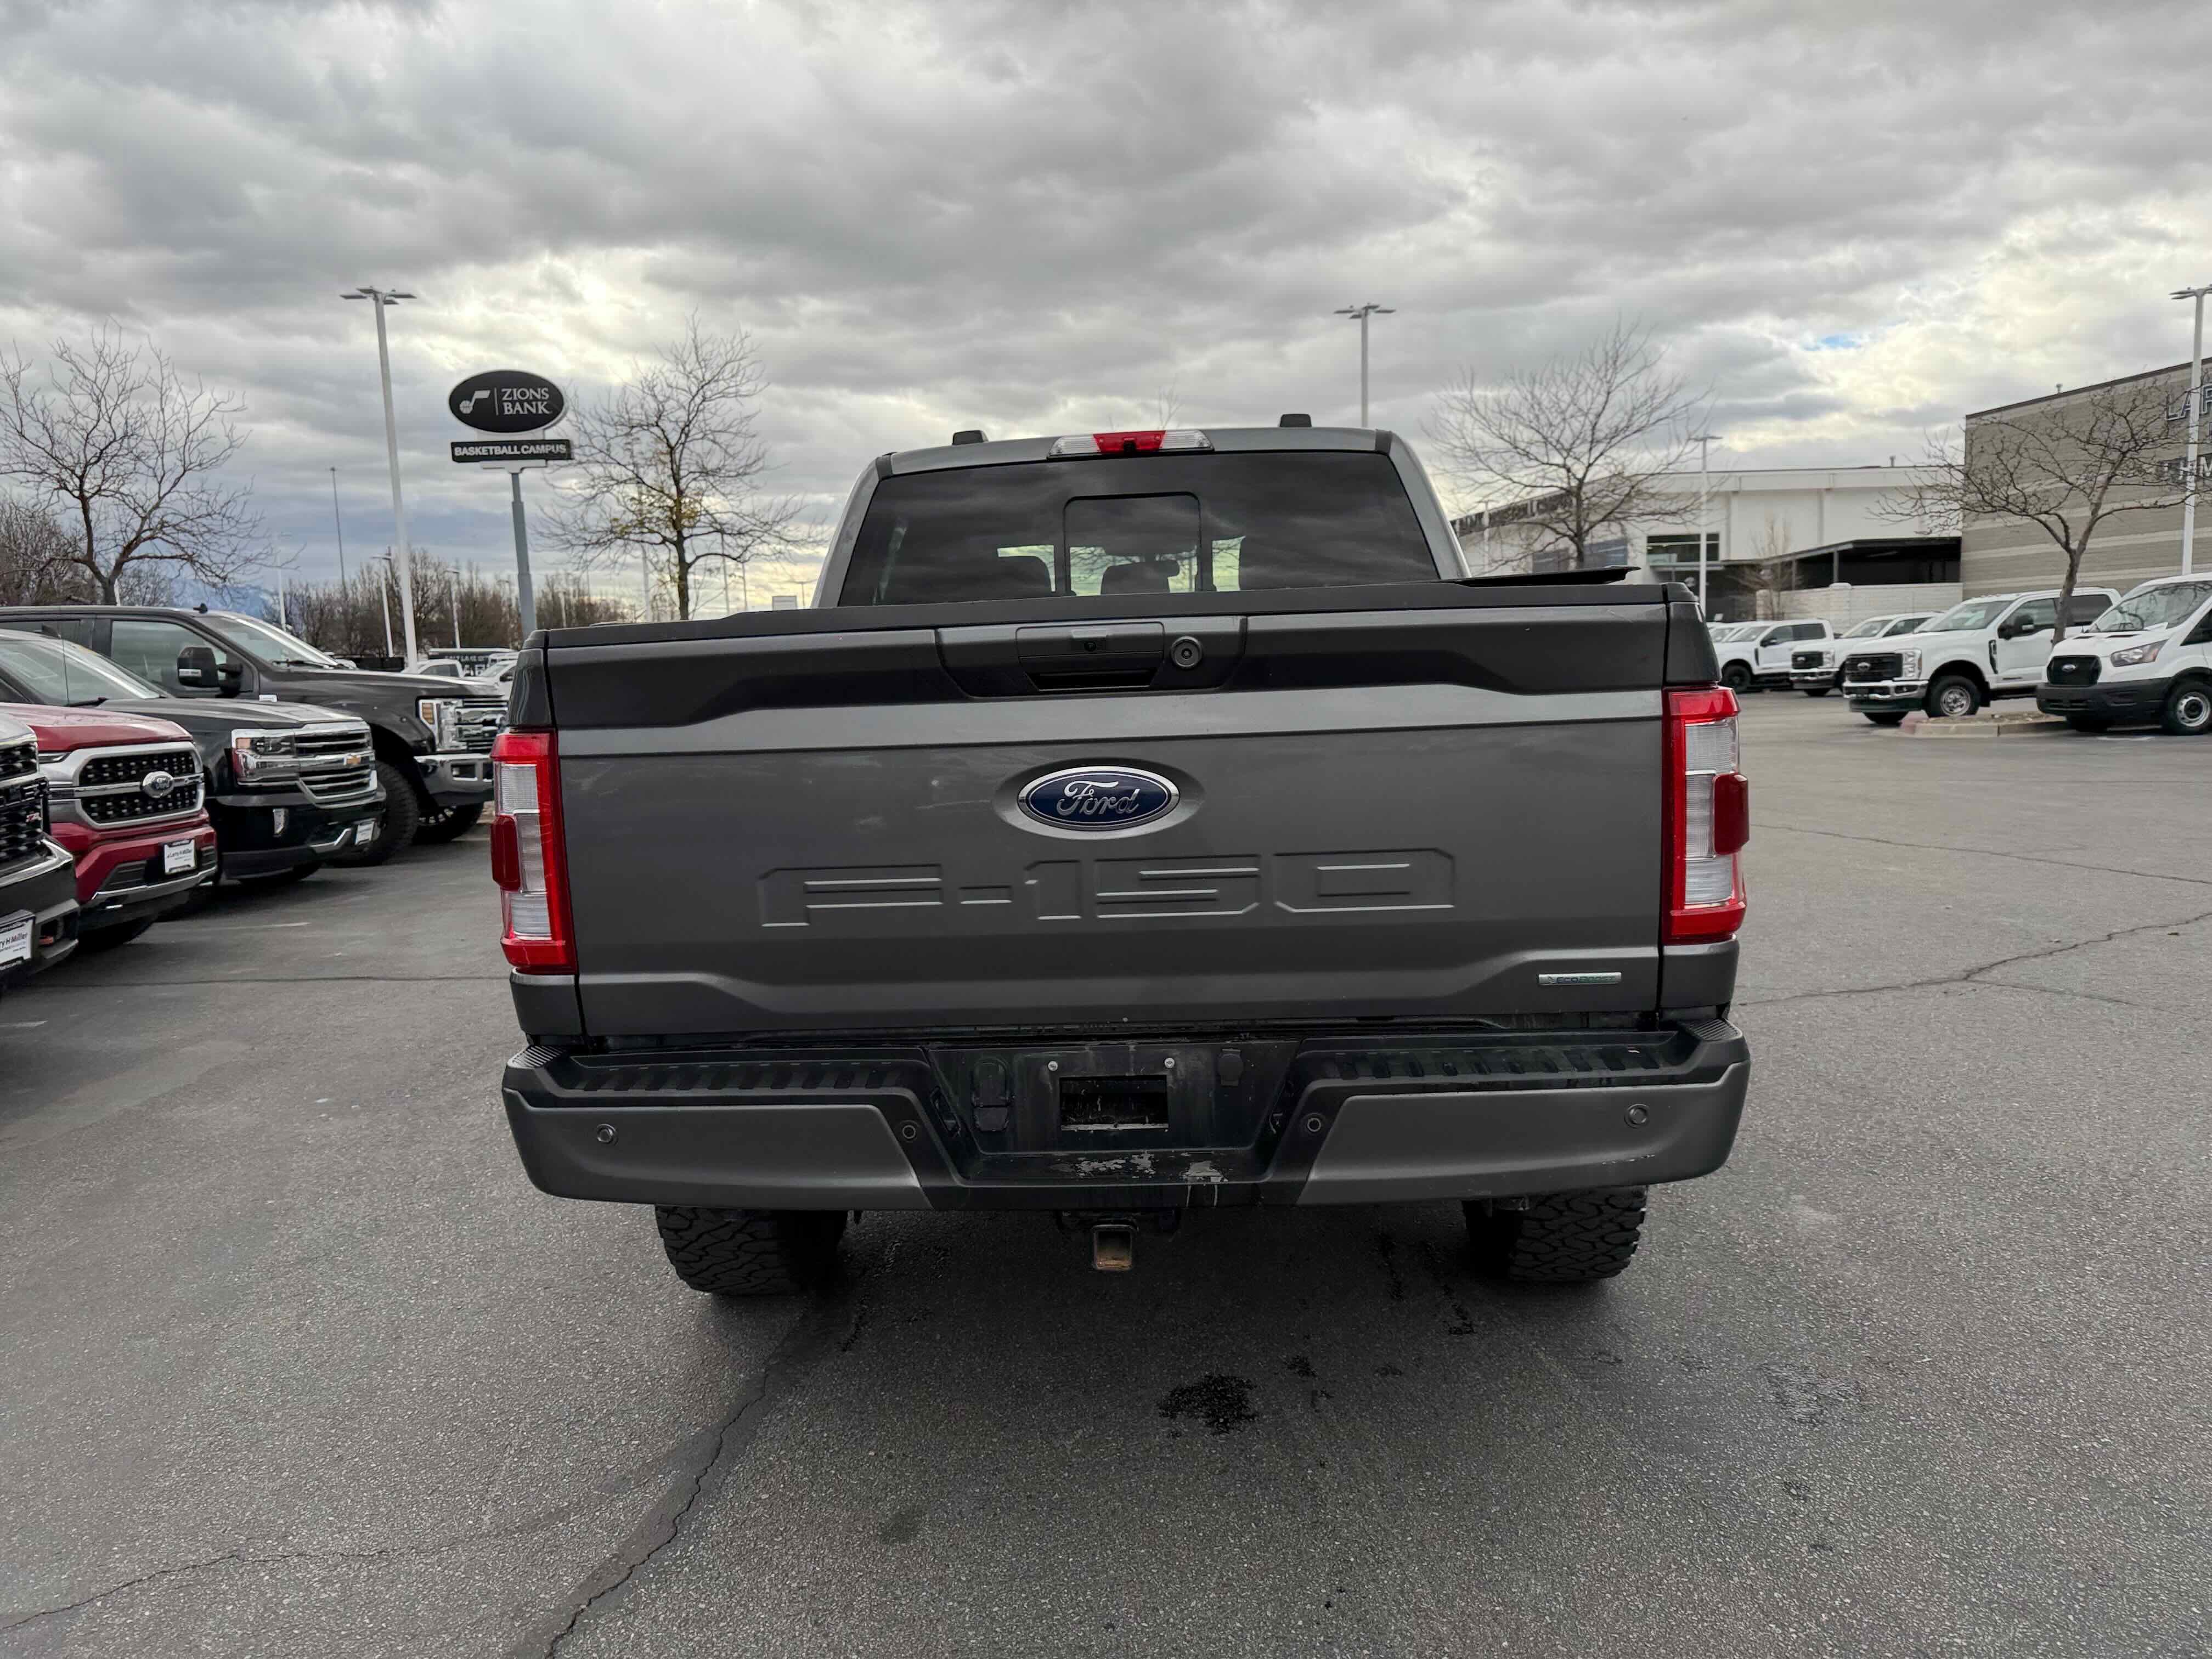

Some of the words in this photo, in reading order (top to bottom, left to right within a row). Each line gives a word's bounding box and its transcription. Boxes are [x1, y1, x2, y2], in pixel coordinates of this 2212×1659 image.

[501, 387, 549, 400] ZIONS
[504, 401, 552, 415] BANK
[454, 445, 521, 456] BASKETBALL
[521, 443, 567, 455] CAMPUS
[1056, 780, 1141, 816] Ford
[757, 849, 1454, 926] F-150
